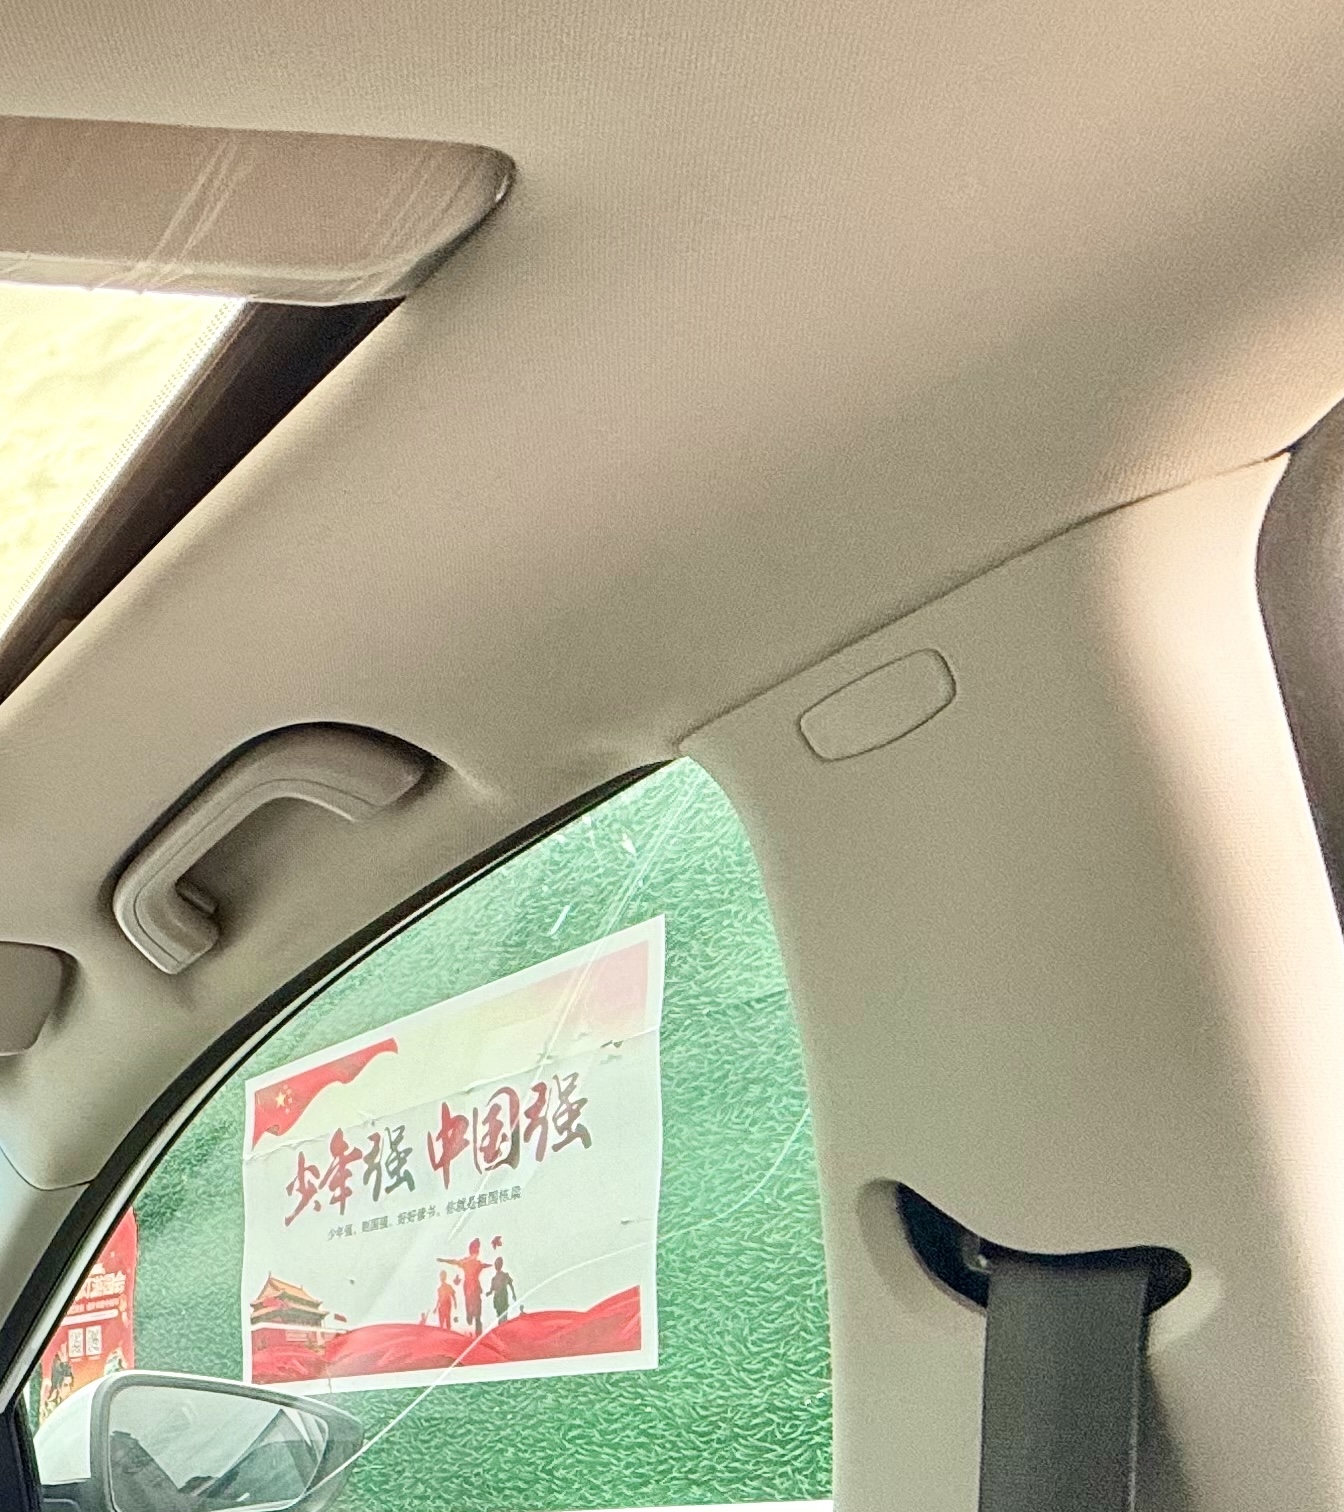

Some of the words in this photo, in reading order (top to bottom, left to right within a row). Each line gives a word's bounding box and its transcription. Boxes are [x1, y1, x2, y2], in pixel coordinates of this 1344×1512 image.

[284, 1126, 416, 1227] 少年强
[428, 1072, 592, 1189] 中国强
